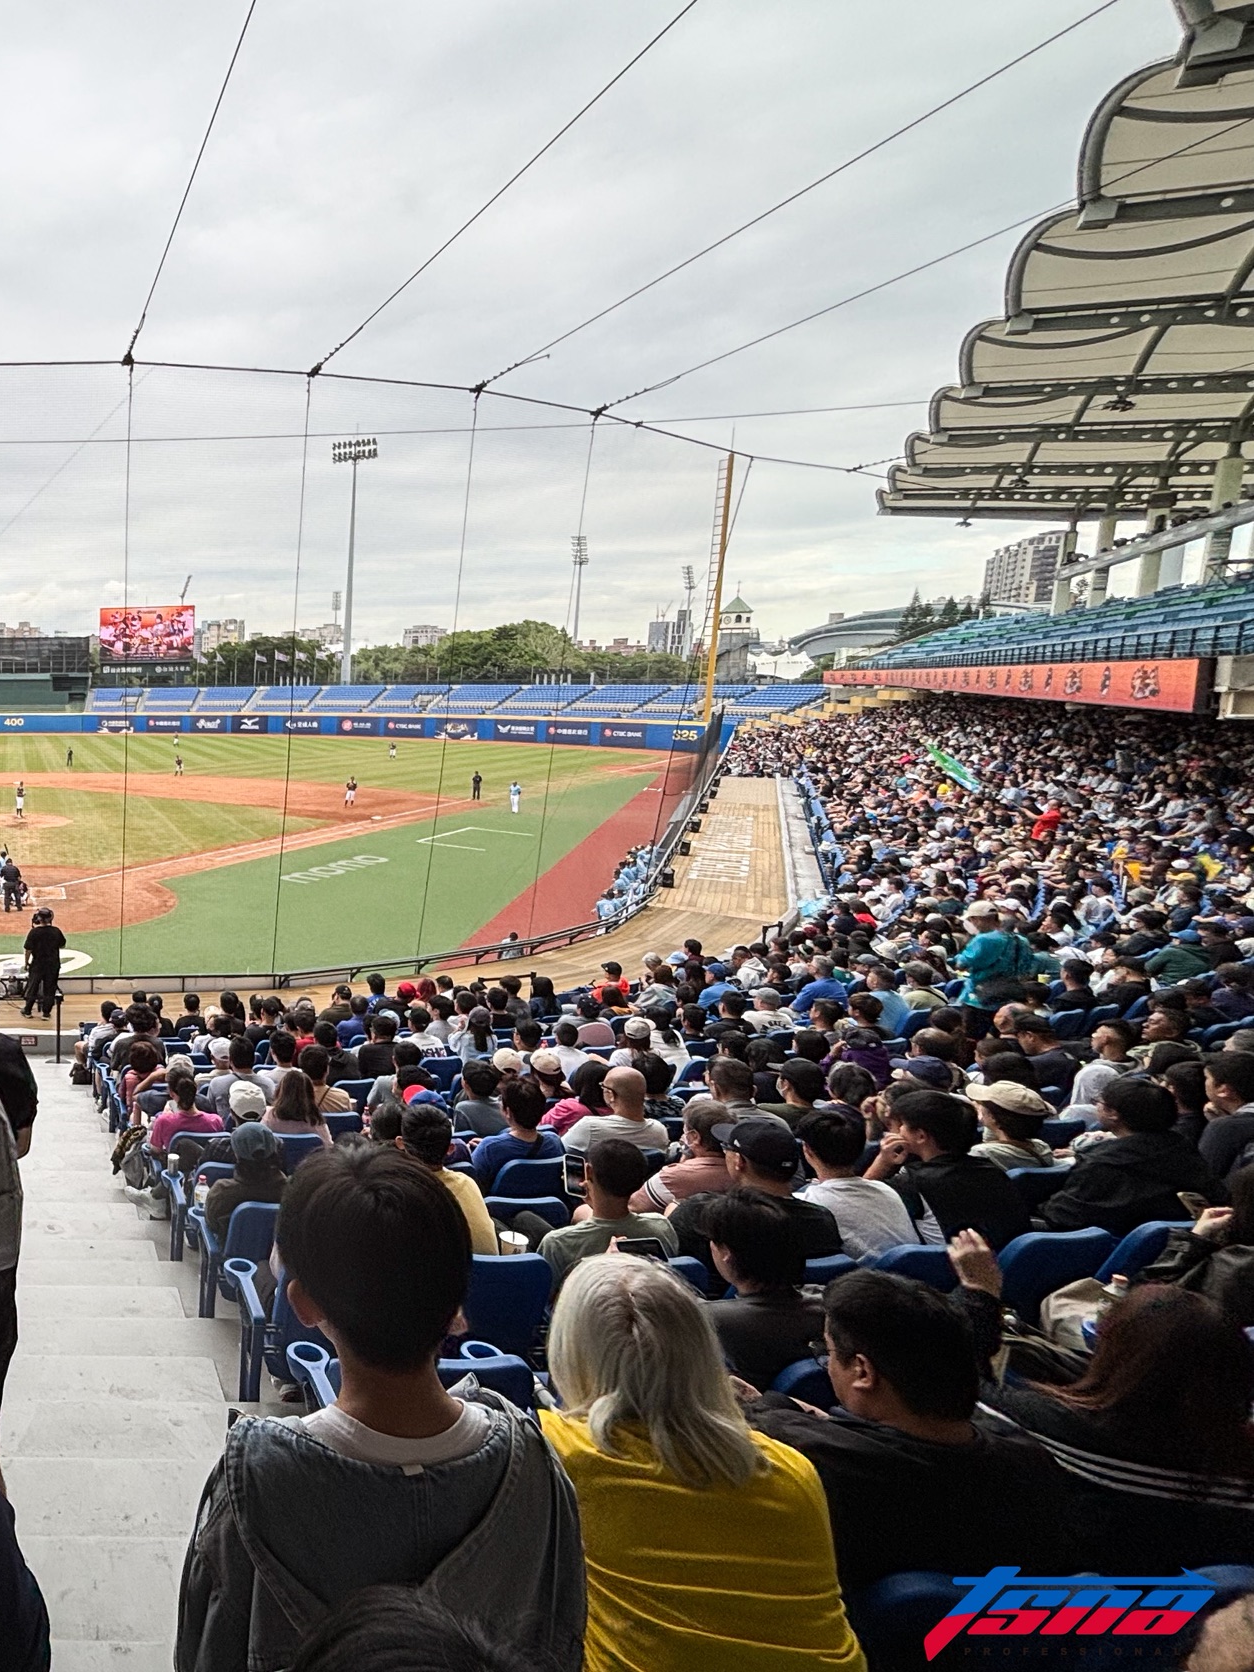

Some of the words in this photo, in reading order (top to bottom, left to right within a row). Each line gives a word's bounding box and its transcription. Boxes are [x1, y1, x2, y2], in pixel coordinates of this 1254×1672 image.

[4, 718, 24, 726] 400
[672, 730, 698, 741] 325
[280, 855, 389, 884] momo
